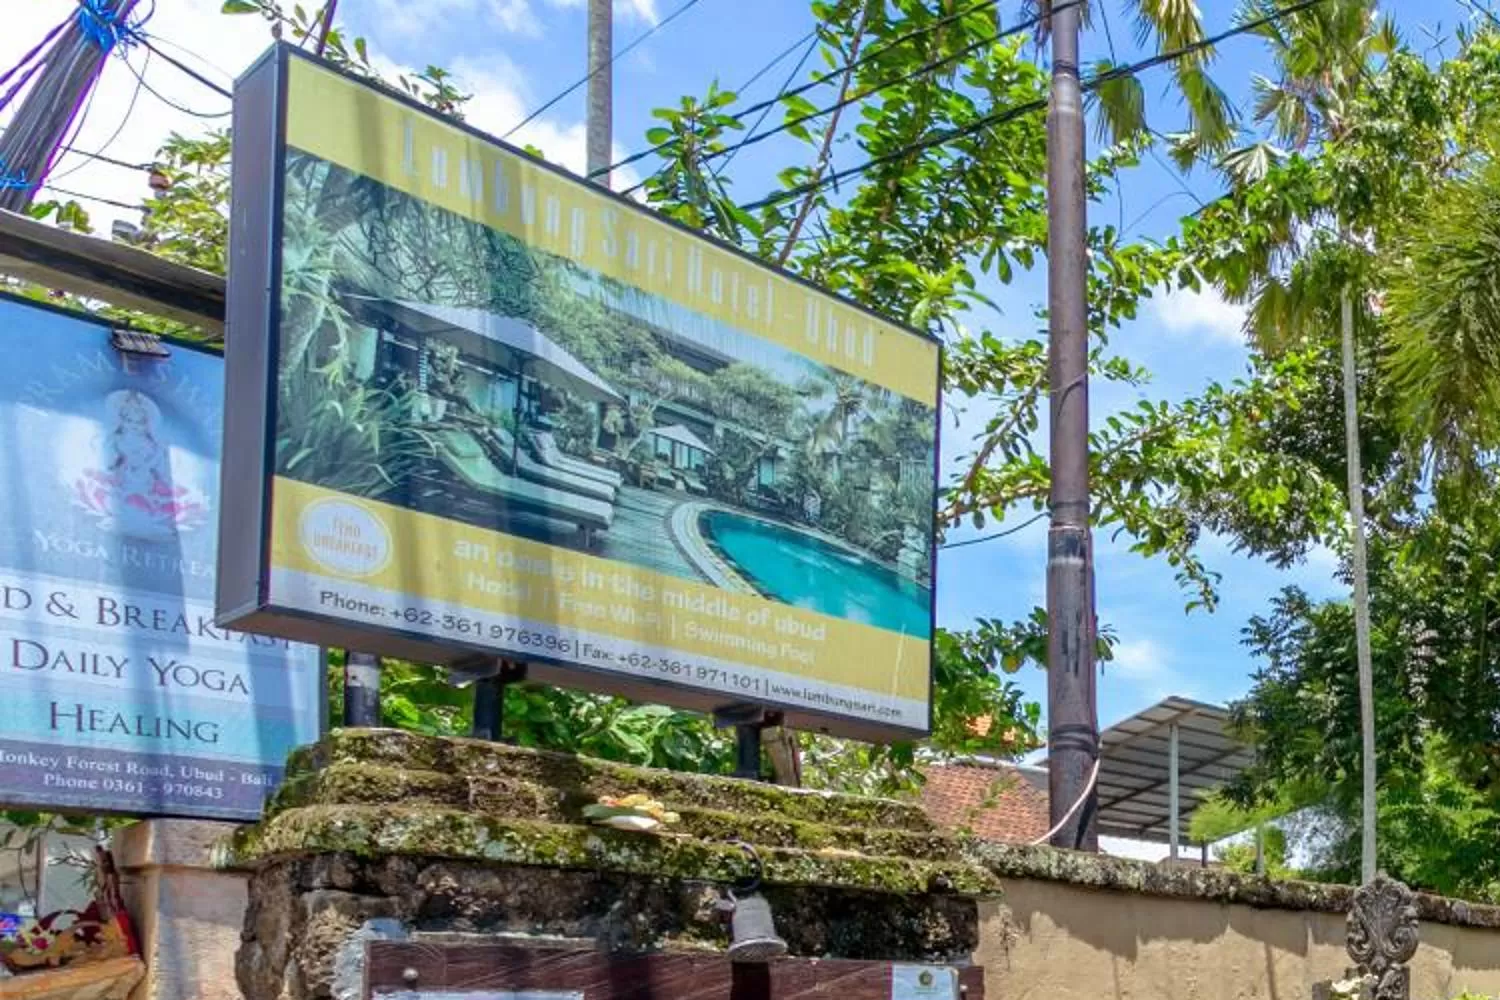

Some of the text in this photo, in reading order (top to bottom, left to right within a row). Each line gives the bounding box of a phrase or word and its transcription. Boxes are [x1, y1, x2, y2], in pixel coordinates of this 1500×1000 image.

[45, 590, 80, 620] &
[319, 589, 386, 618] Phone:
[489, 624, 572, 654] 976396
[10, 638, 250, 695] DAILY YOGA
[49, 700, 221, 744] HEALING
[43, 773, 99, 791] Phone
[102, 778, 145, 794] 0361
[66, 755, 121, 774] Forest
[181, 764, 225, 783] Ubud
